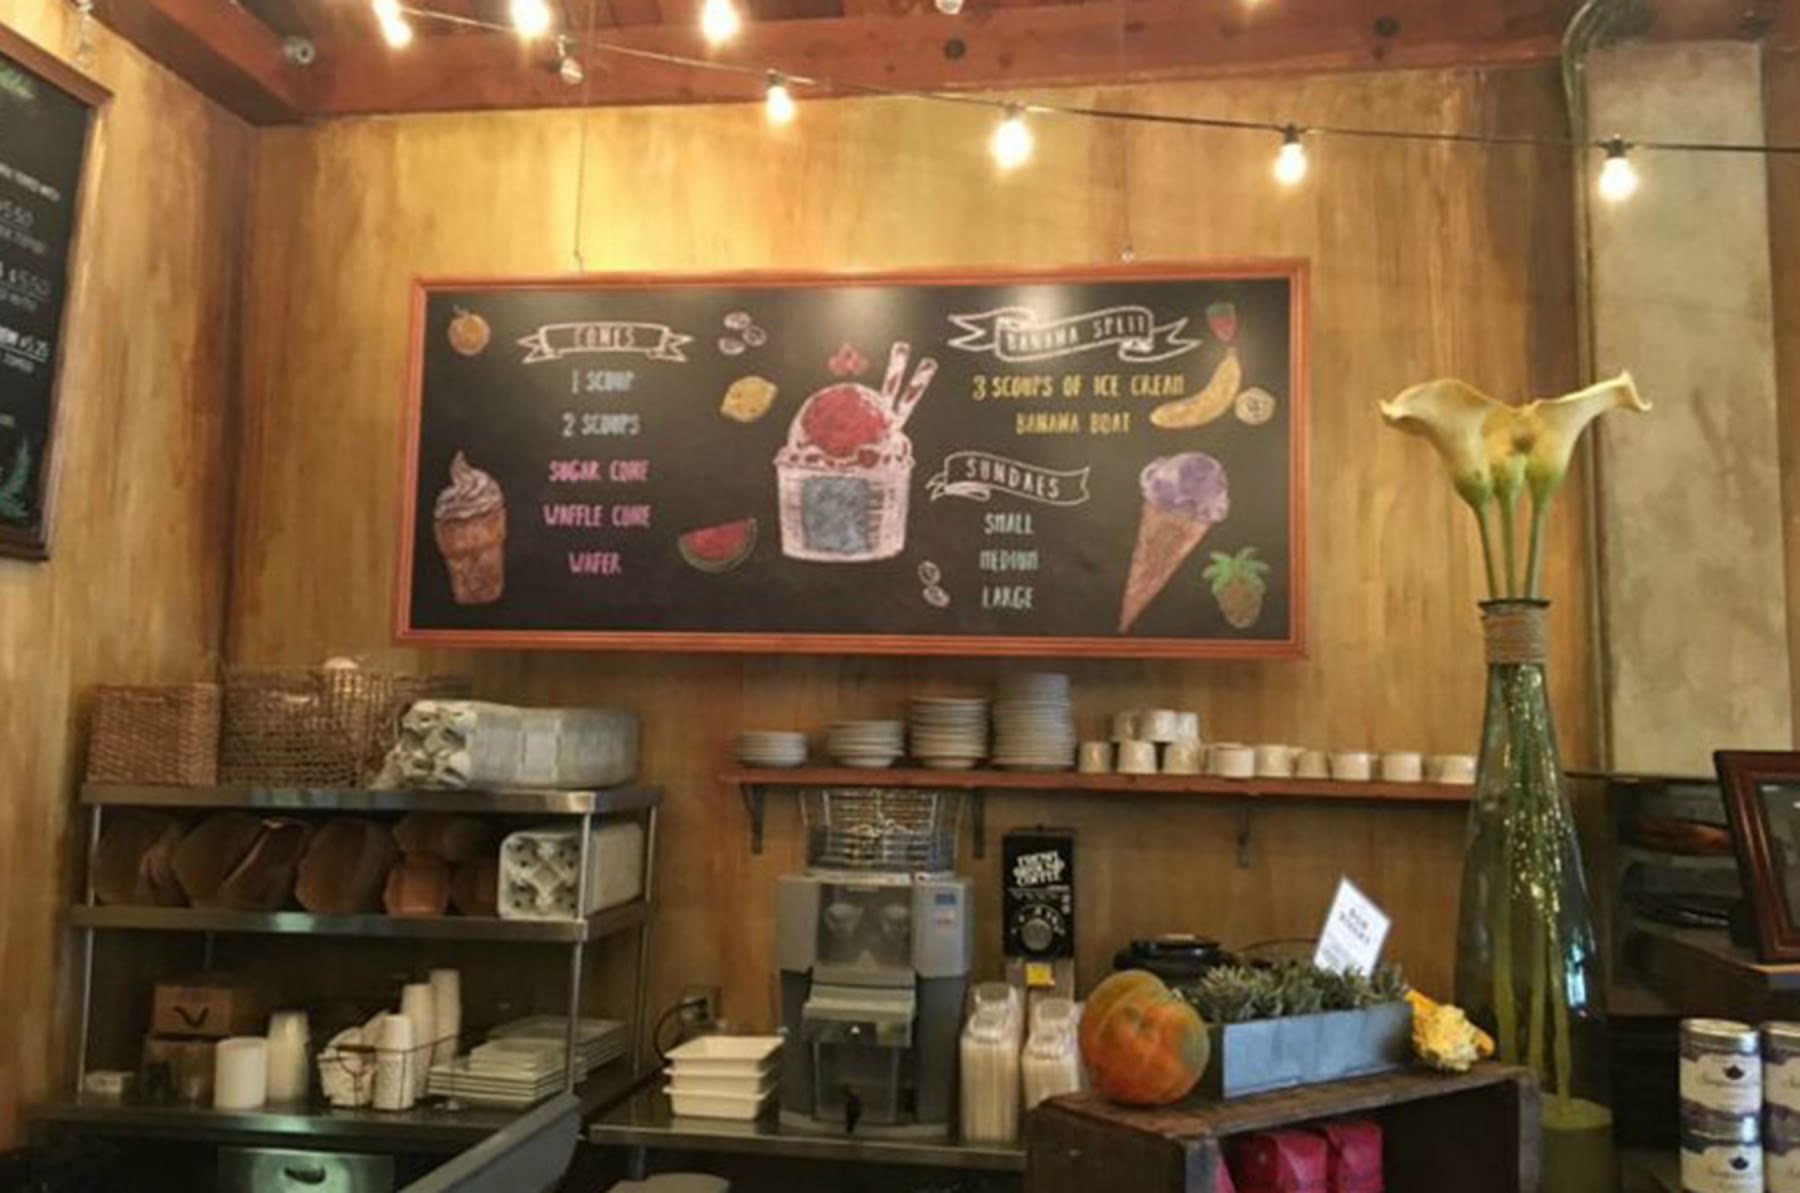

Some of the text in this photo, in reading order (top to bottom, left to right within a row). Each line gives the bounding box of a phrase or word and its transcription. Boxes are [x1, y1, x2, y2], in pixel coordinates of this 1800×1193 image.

[574, 324, 636, 349] CONES
[1007, 314, 1146, 350] BANANA SPLIT
[571, 369, 636, 395] 1 SCOOP
[972, 373, 1185, 401] 3 SCOOPS OF ICE CREAM
[562, 412, 640, 437] 2 SCOOPS
[1015, 411, 1132, 435] BANANA BOAT
[549, 459, 650, 482] SUGAR CONE
[965, 457, 1060, 499] SUNDAES
[543, 504, 651, 528] WAFFLE CONE
[984, 513, 1035, 534] SMALL
[568, 552, 622, 575] WAFER
[979, 549, 1040, 571] MEDIUM
[981, 585, 1034, 609] LARGE
